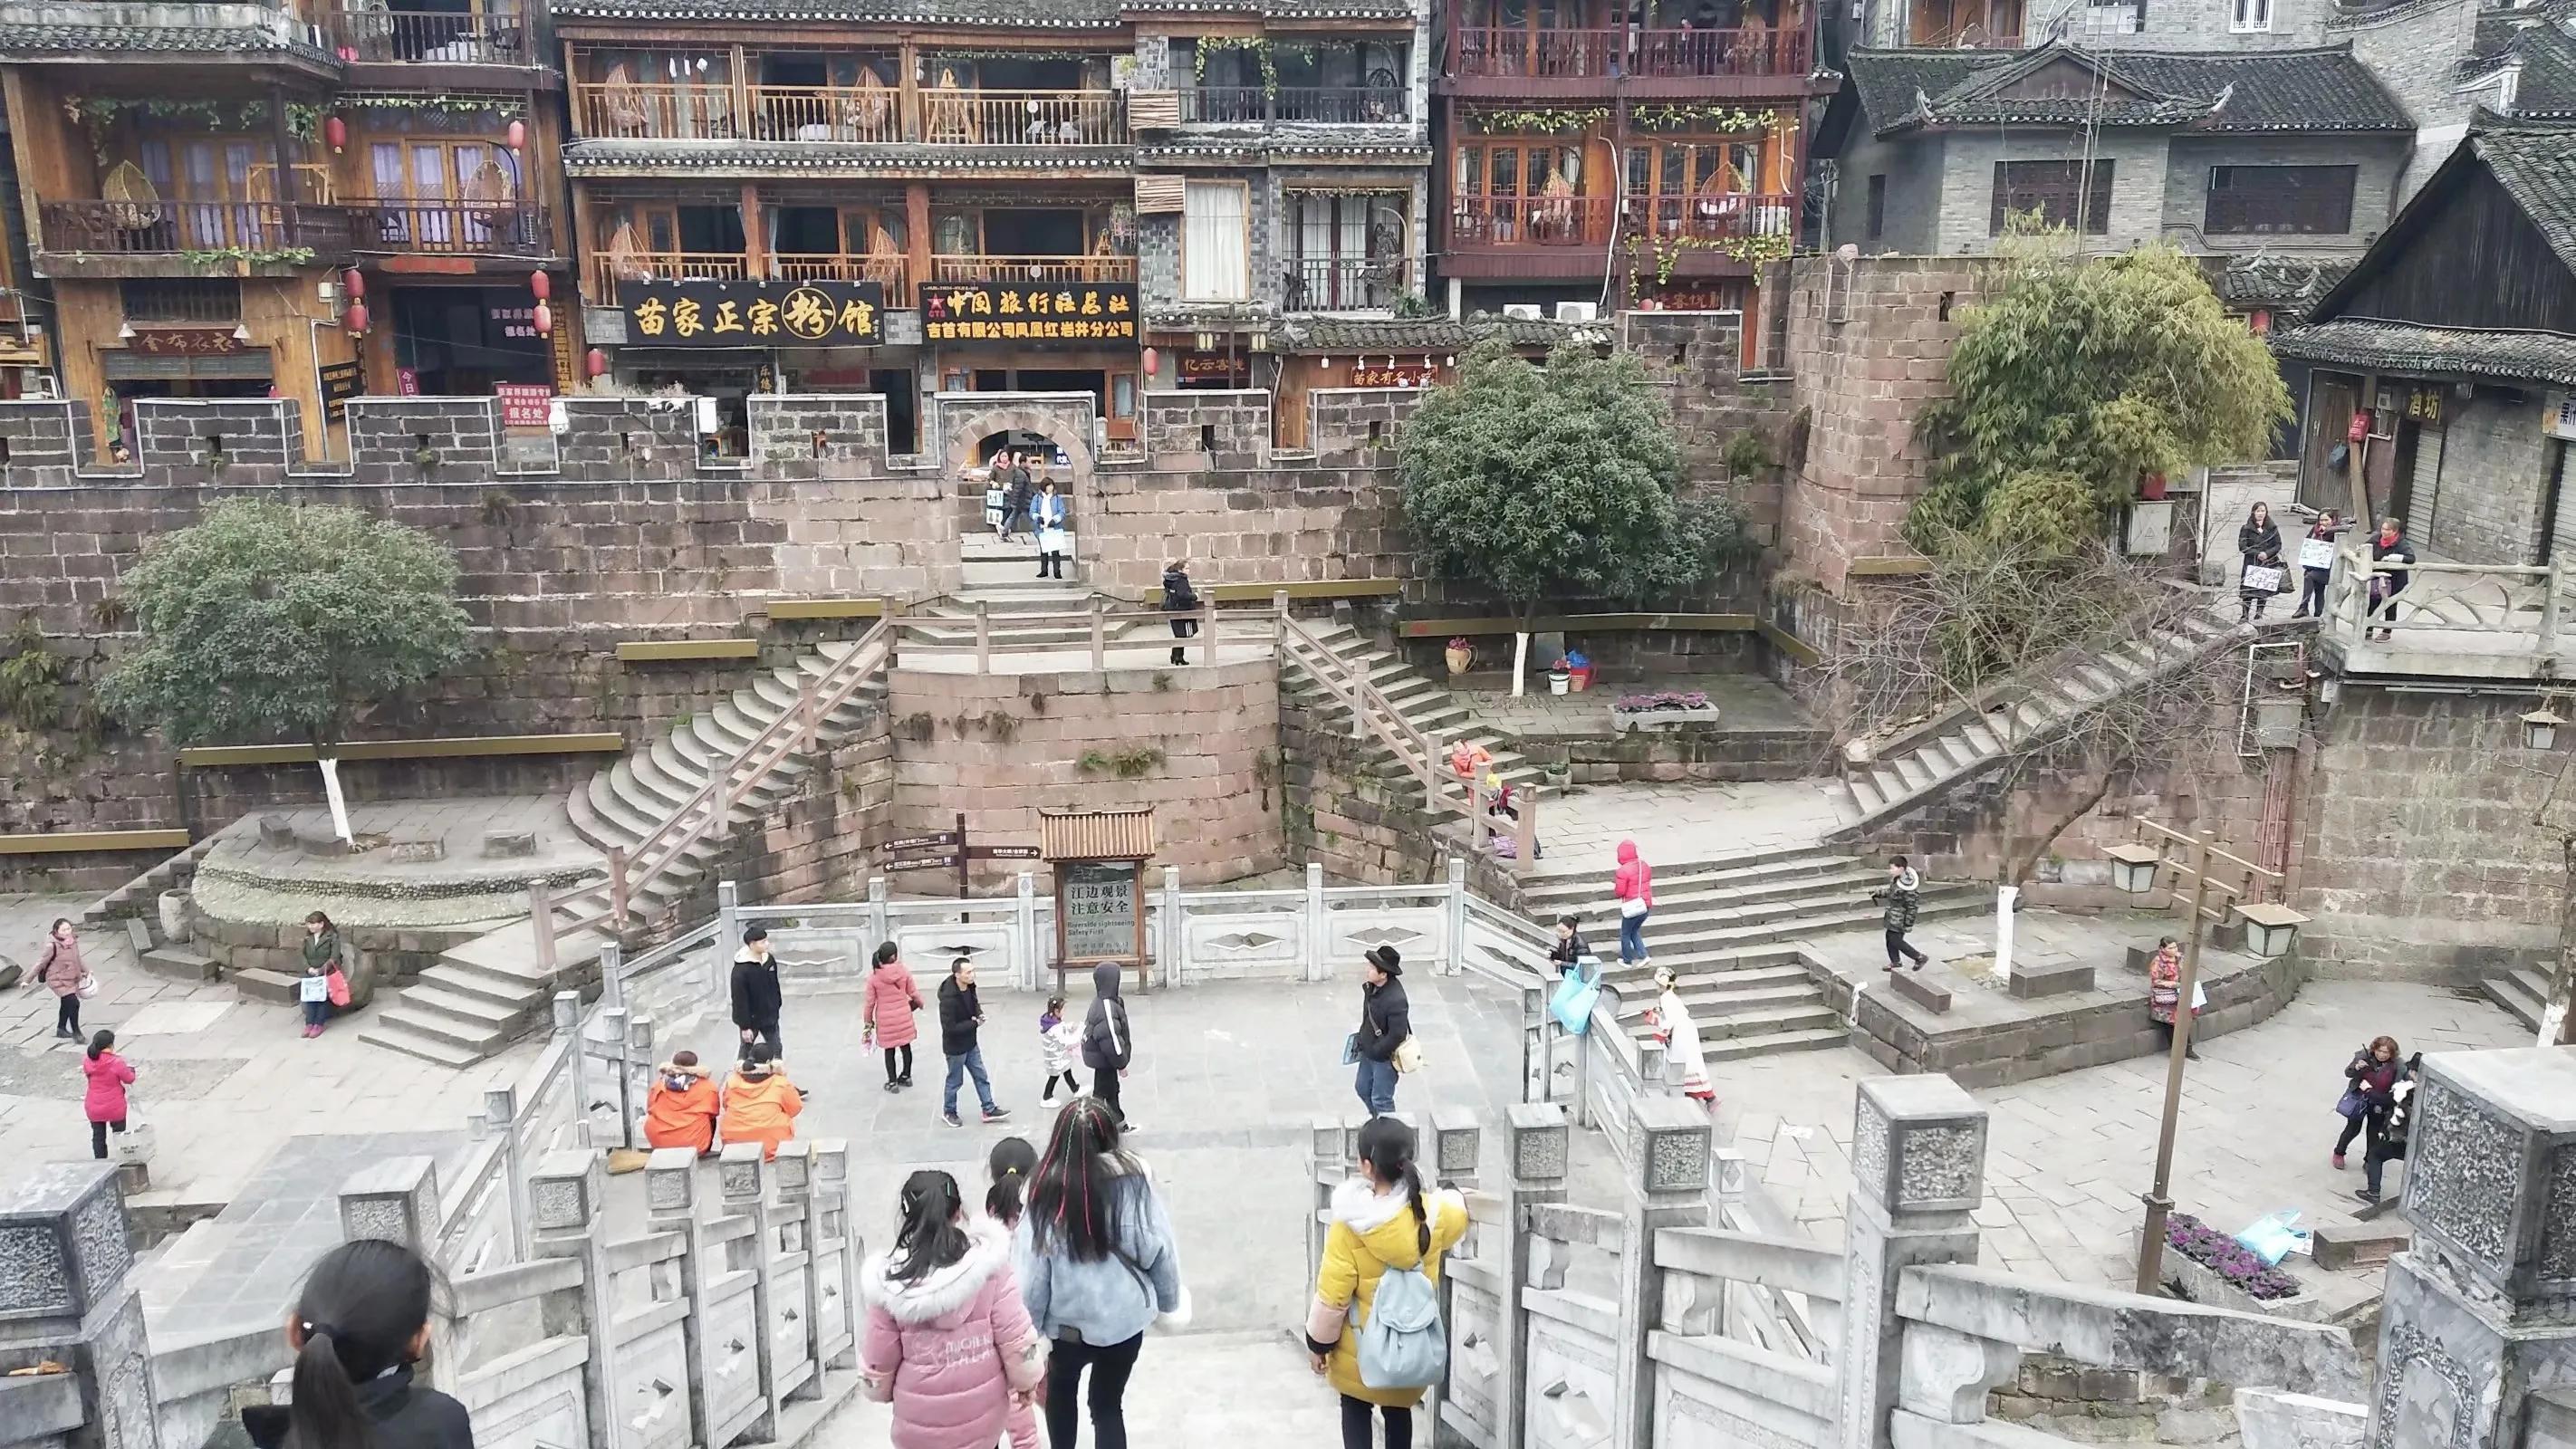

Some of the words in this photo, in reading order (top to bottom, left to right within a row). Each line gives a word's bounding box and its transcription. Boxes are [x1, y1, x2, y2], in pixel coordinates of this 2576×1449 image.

[633, 292, 875, 337] 苗家正宗粉馆
[2408, 390, 2439, 419] 酒坊
[1072, 885, 1128, 899] 江边观景
[1072, 900, 1129, 915] 注意安全
